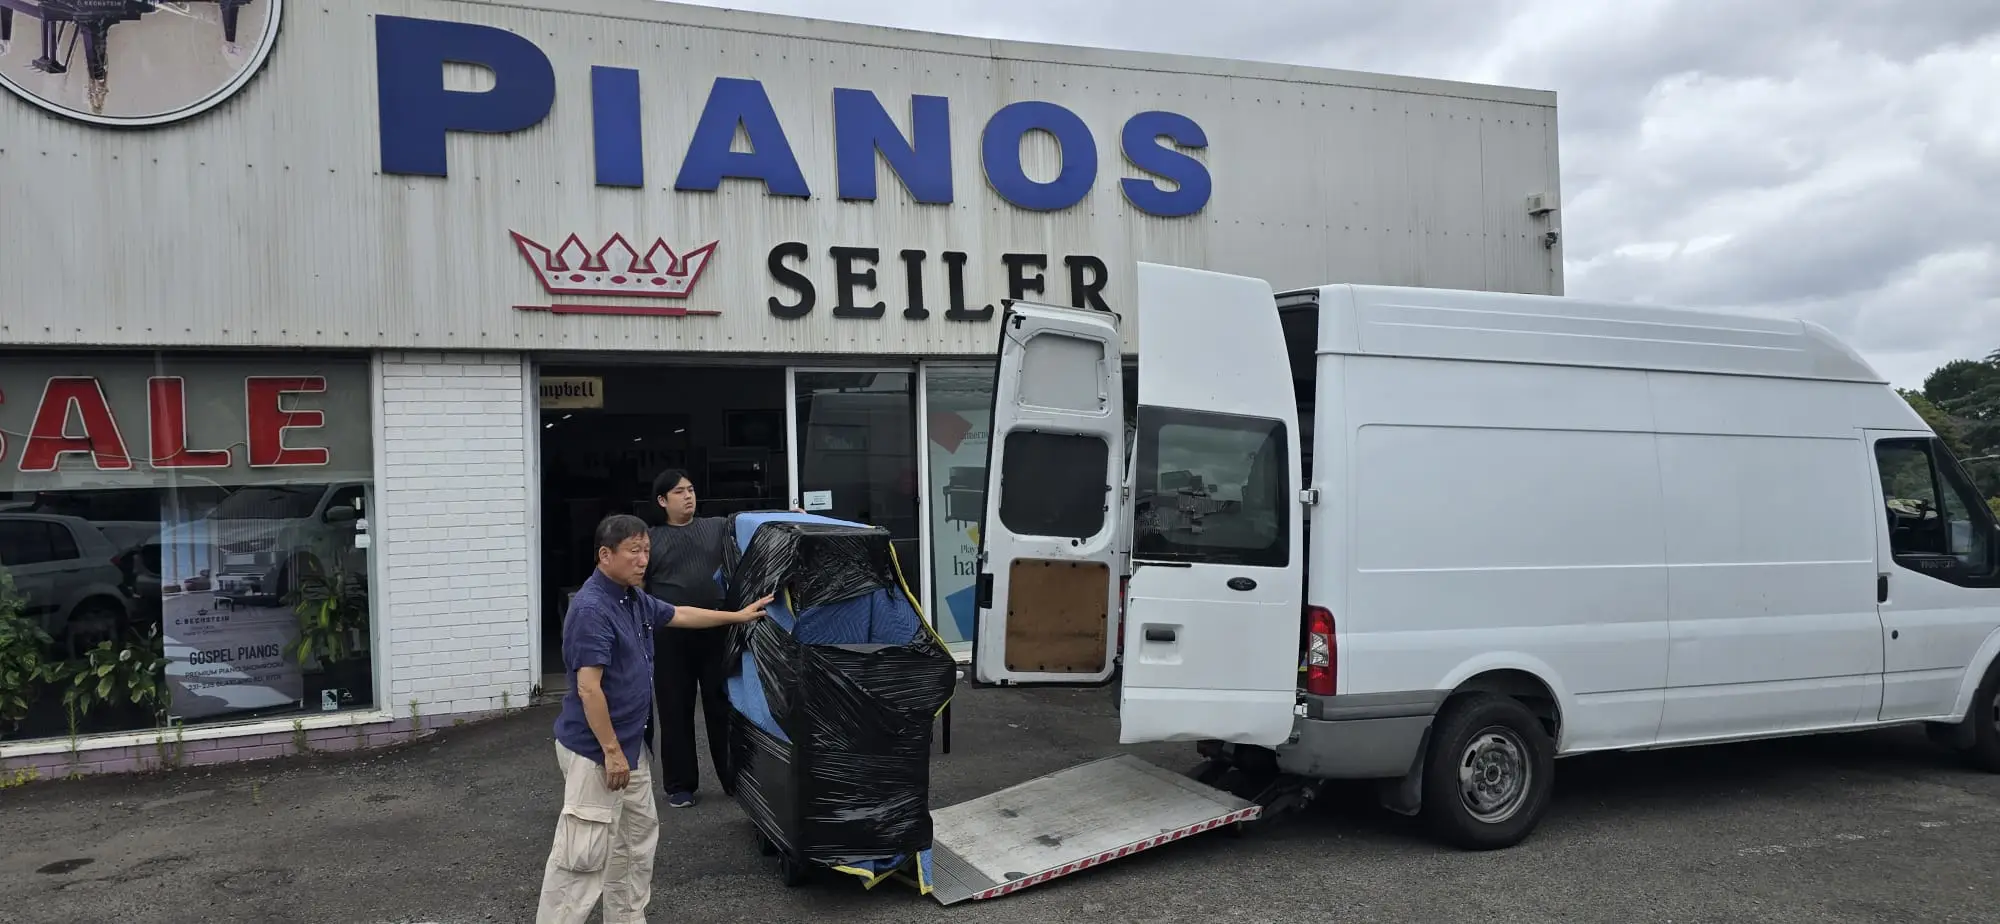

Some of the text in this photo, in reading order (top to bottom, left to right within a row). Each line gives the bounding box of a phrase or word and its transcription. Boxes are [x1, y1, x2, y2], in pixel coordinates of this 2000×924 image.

[375, 14, 1213, 217] PIANOS
[768, 241, 1121, 320] SEILER
[0, 375, 330, 471] ALE
[184, 615, 230, 625] BECHSTEIN
[184, 669, 218, 679] PREMIUM
[190, 644, 279, 666] GOSPEL PIANOS
